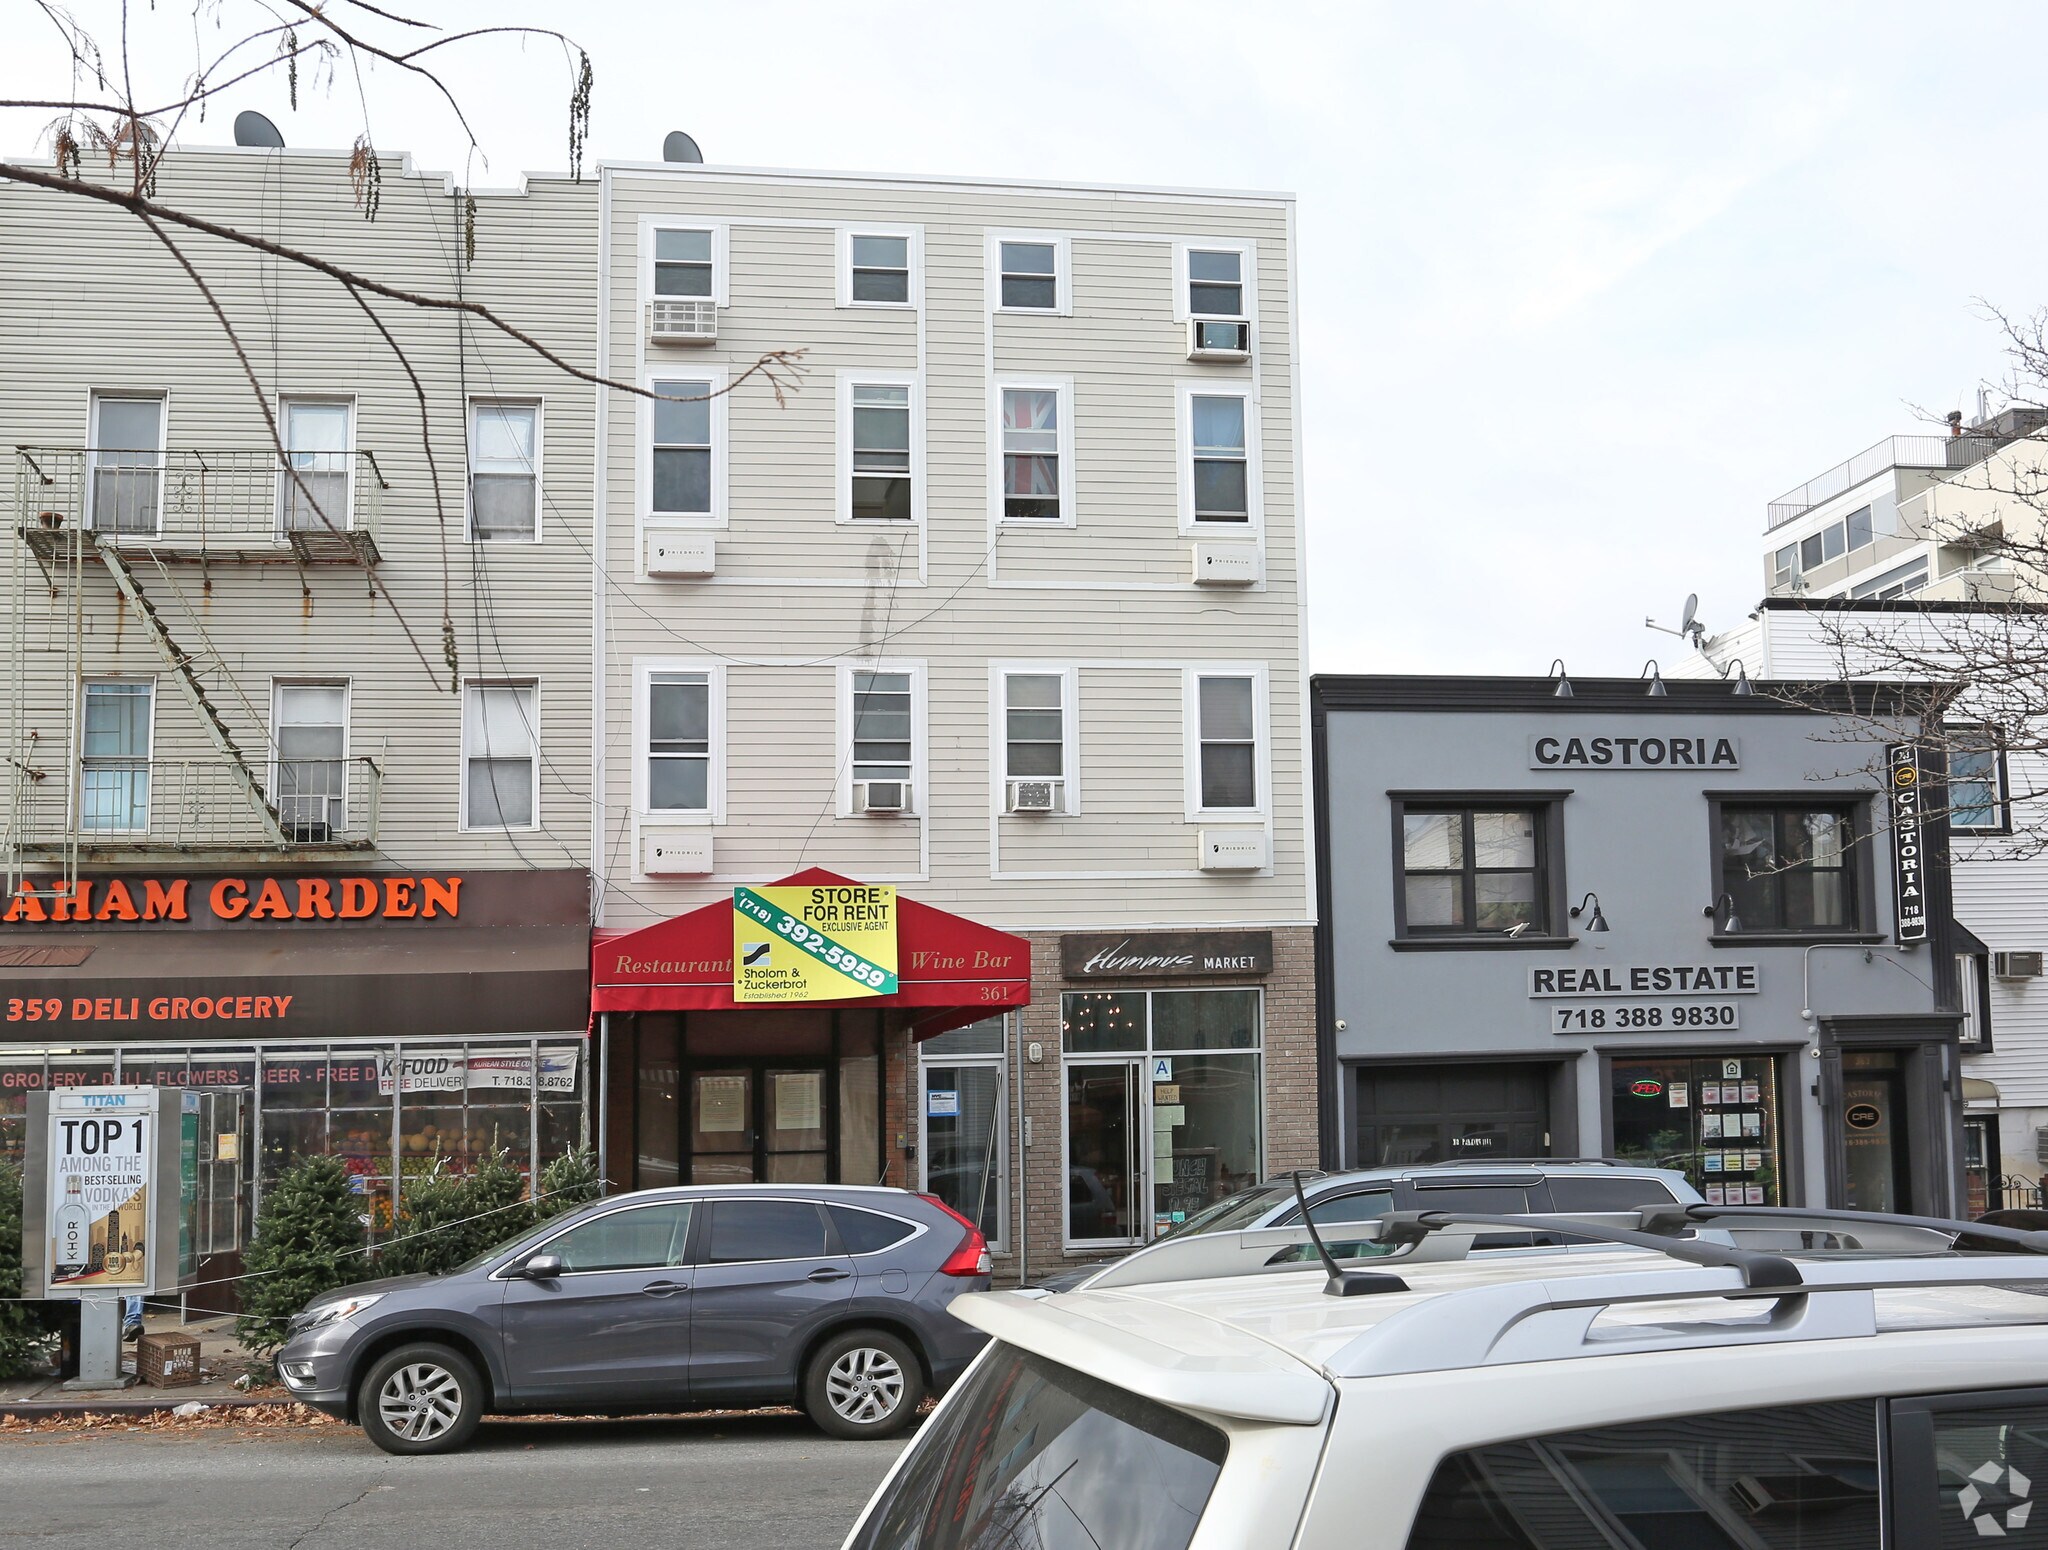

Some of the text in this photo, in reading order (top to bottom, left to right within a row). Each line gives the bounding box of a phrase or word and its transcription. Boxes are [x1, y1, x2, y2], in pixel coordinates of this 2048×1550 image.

[1534, 737, 1738, 765] CASTORIA
[1897, 791, 1920, 898] CASTORIA
[0, 877, 462, 922] AHAM GARDEN
[811, 888, 881, 904] STORE
[803, 905, 889, 921] FOR RENT
[1904, 905, 1920, 916] 718
[822, 921, 889, 932] EXCLUSIVE AGENT
[739, 896, 886, 988] (718) 392-5959
[911, 951, 1012, 970] Wine Bar
[1083, 938, 1256, 973] Hummus MARKET
[613, 955, 733, 974] Restaurant
[744, 968, 801, 979] Sholom &
[1534, 966, 1756, 993] REAL ESTATE
[744, 979, 807, 990] Zuckerbrot
[743, 990, 809, 1000] Established 1962
[981, 986, 1009, 1001] 361
[6, 995, 293, 1021] 359 DELI GROCERY
[1557, 1006, 1735, 1029] 718 388 9830
[381, 1058, 449, 1077] KFOOD
[473, 1060, 500, 1068] KOREAN
[501, 1059, 520, 1068] STYLE
[1155, 1060, 1168, 1074] A
[3, 1072, 87, 1088] GROCERY
[102, 1071, 140, 1086] DLI
[156, 1069, 239, 1086] FLOWERS
[316, 1067, 359, 1082] FREE
[492, 1076, 573, 1087] T. 718.38.8762
[1631, 1083, 1663, 1094] OPEN
[82, 1094, 126, 1106] TITAN
[1851, 1112, 1875, 1121] CRE
[60, 1119, 142, 1155] TOP 1
[59, 1155, 142, 1173] AMONG THE
[1173, 1157, 1207, 1177] UNCH
[84, 1174, 142, 1186] BEST-SELLING
[84, 1187, 142, 1202] VODKA'S
[91, 1202, 143, 1211] IN THE WORLD
[67, 1220, 79, 1260] KHOR
